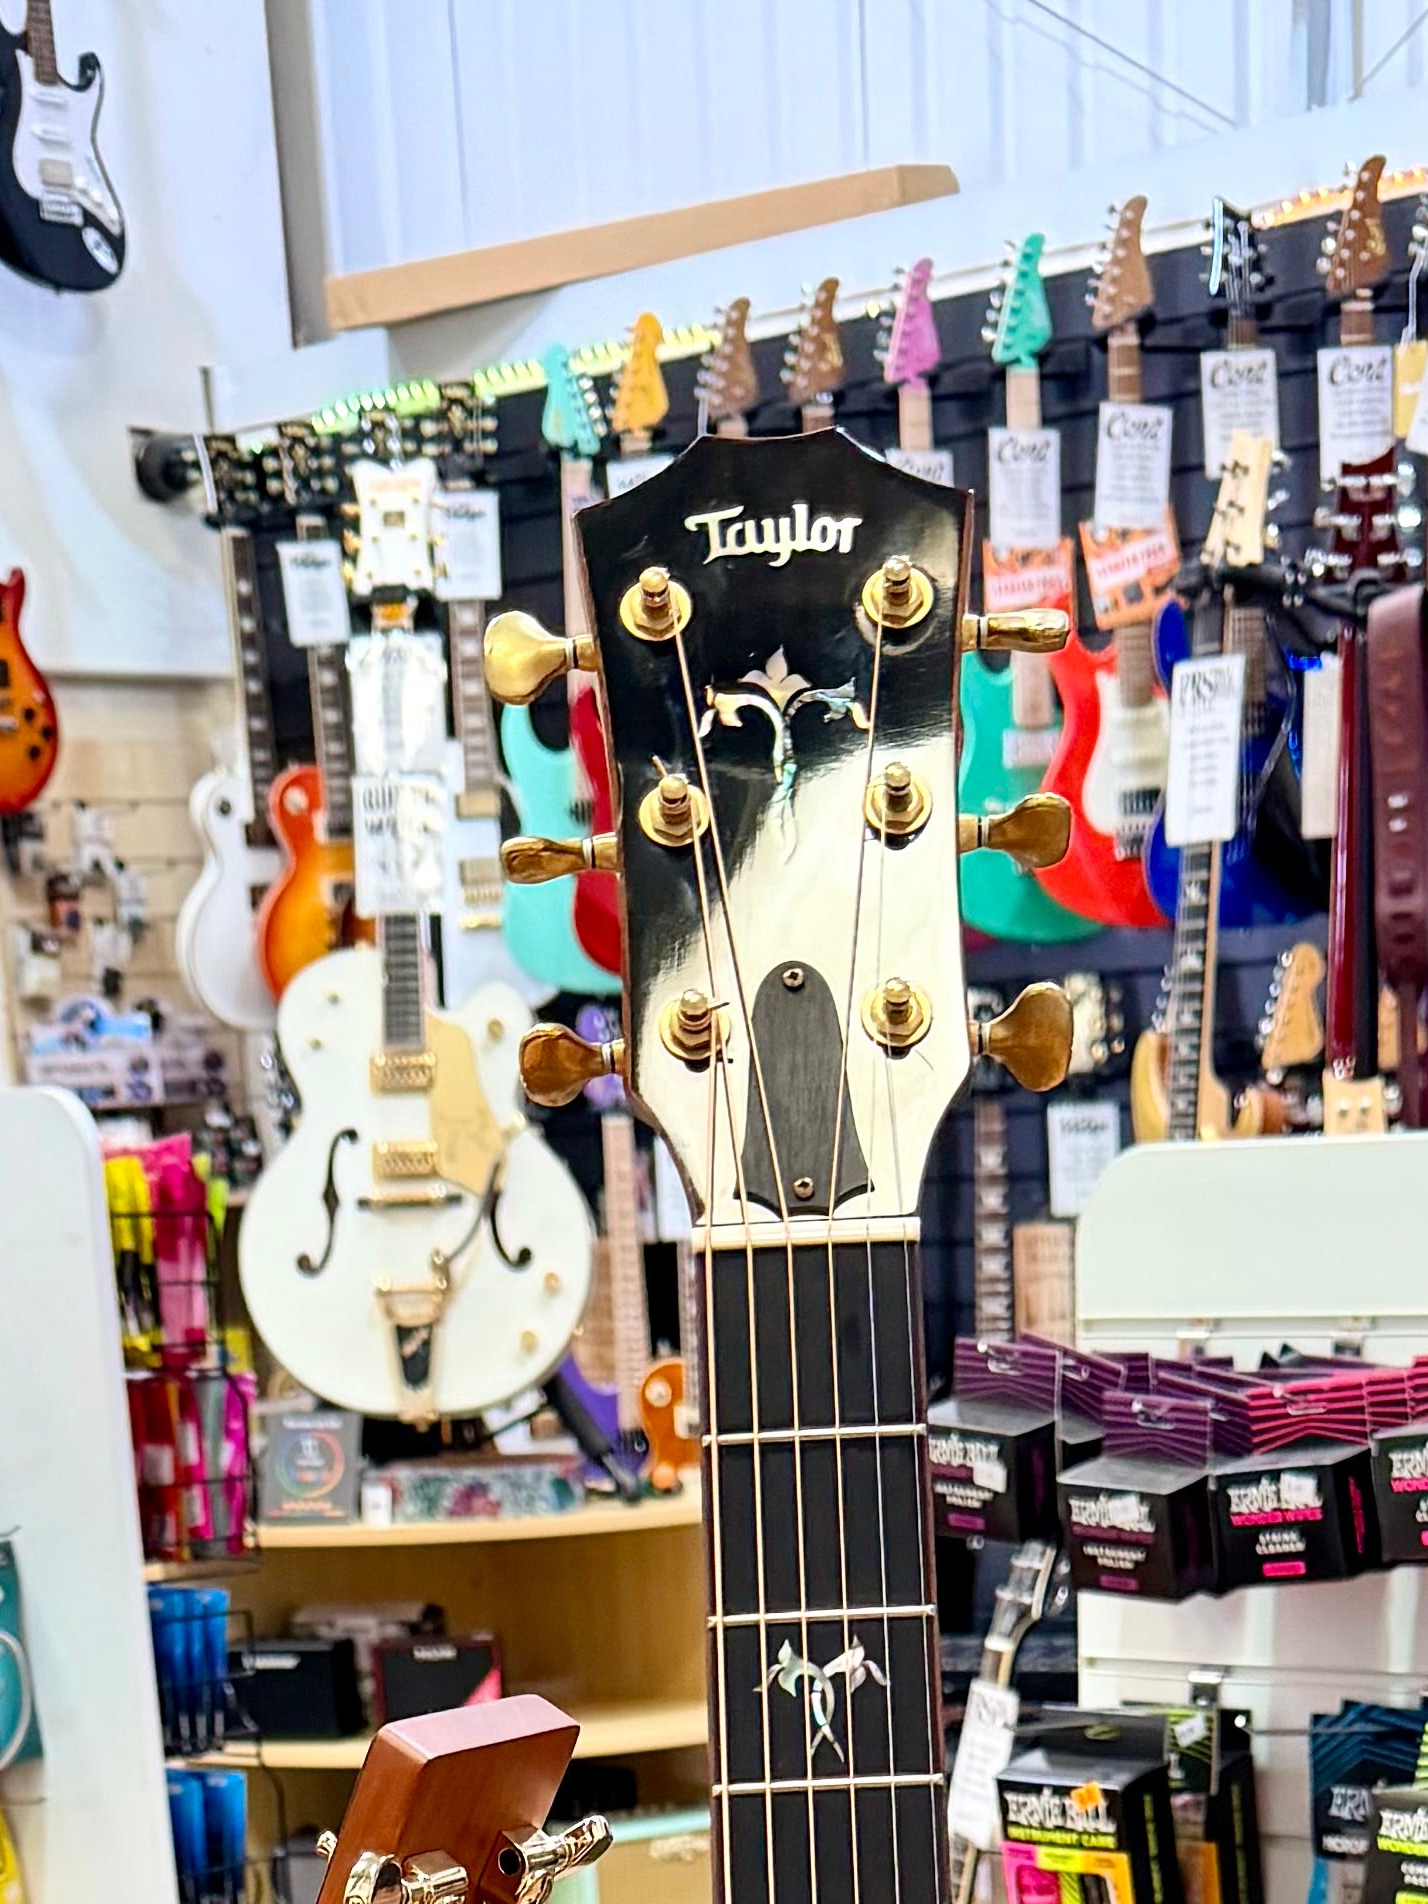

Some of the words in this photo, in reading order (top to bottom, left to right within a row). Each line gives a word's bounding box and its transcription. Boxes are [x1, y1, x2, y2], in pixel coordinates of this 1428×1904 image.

[1210, 357, 1266, 390] Cort
[1329, 355, 1388, 388] Cort
[1106, 407, 1163, 441] Cort
[996, 435, 1051, 465] Cort
[685, 504, 863, 567] Taylor
[1003, 1786, 1060, 1828] ERNIE
[1329, 1784, 1369, 1822] ERN
